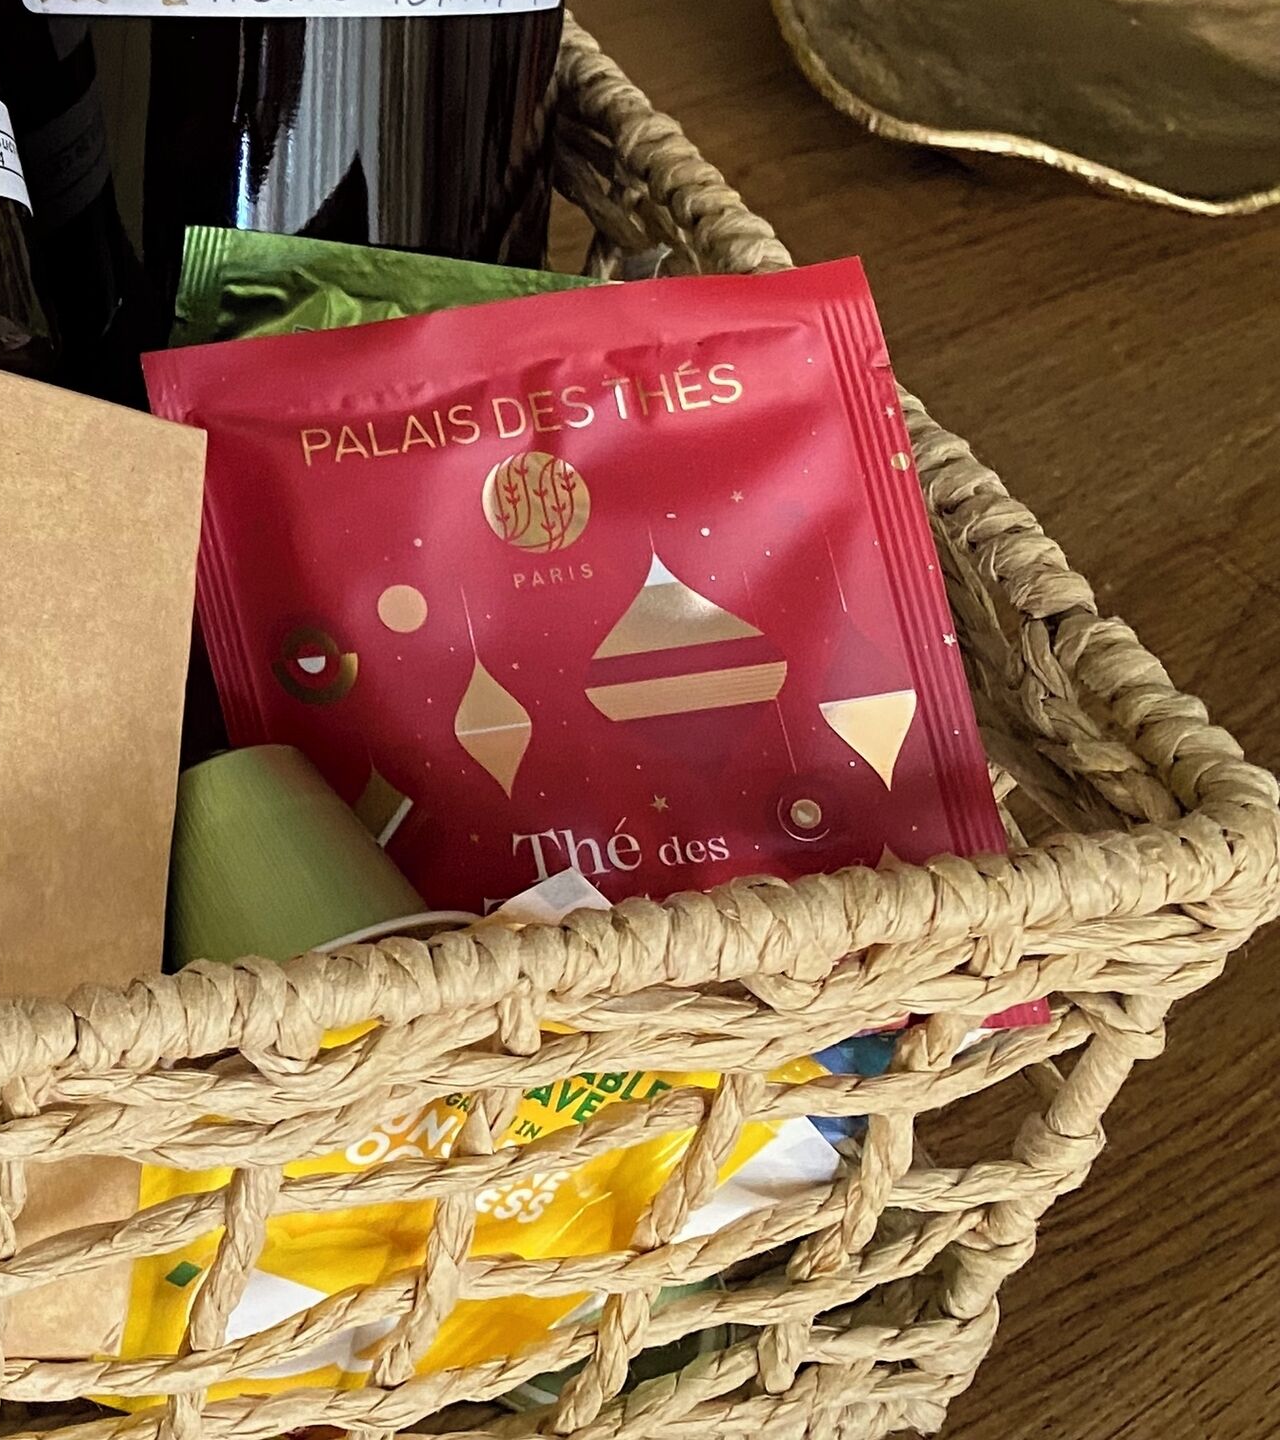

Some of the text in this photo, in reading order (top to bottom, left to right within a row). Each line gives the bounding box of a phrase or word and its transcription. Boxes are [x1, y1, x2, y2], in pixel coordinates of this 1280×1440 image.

[299, 360, 743, 466] PALAIS DES THÉS
[513, 563, 594, 589] PARIS
[512, 816, 730, 883] Thé des
